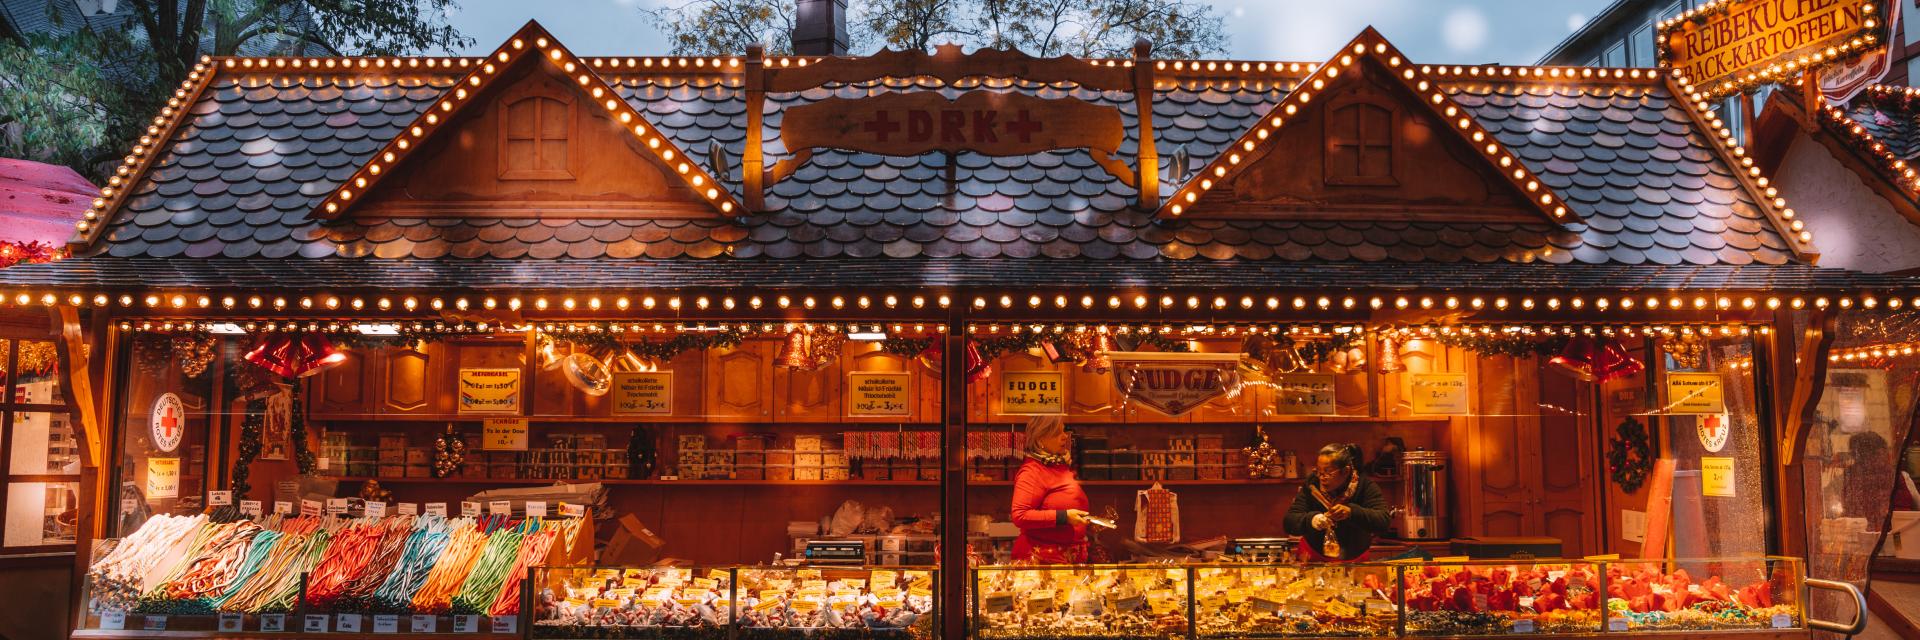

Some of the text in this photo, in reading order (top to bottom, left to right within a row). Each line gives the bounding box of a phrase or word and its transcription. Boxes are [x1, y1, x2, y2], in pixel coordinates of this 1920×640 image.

[1685, 0, 1839, 60] REIBEKUCH
[1684, 2, 1859, 85] BACK-KARTOFFELN
[907, 109, 998, 143] DRK
[1009, 382, 1056, 390] FUDGE
[1131, 368, 1220, 390] FUDGE
[156, 396, 182, 418] DEUTSCHES
[155, 422, 182, 448] ROTES KREUZ
[1699, 424, 1727, 448] ROTES KREUZ
